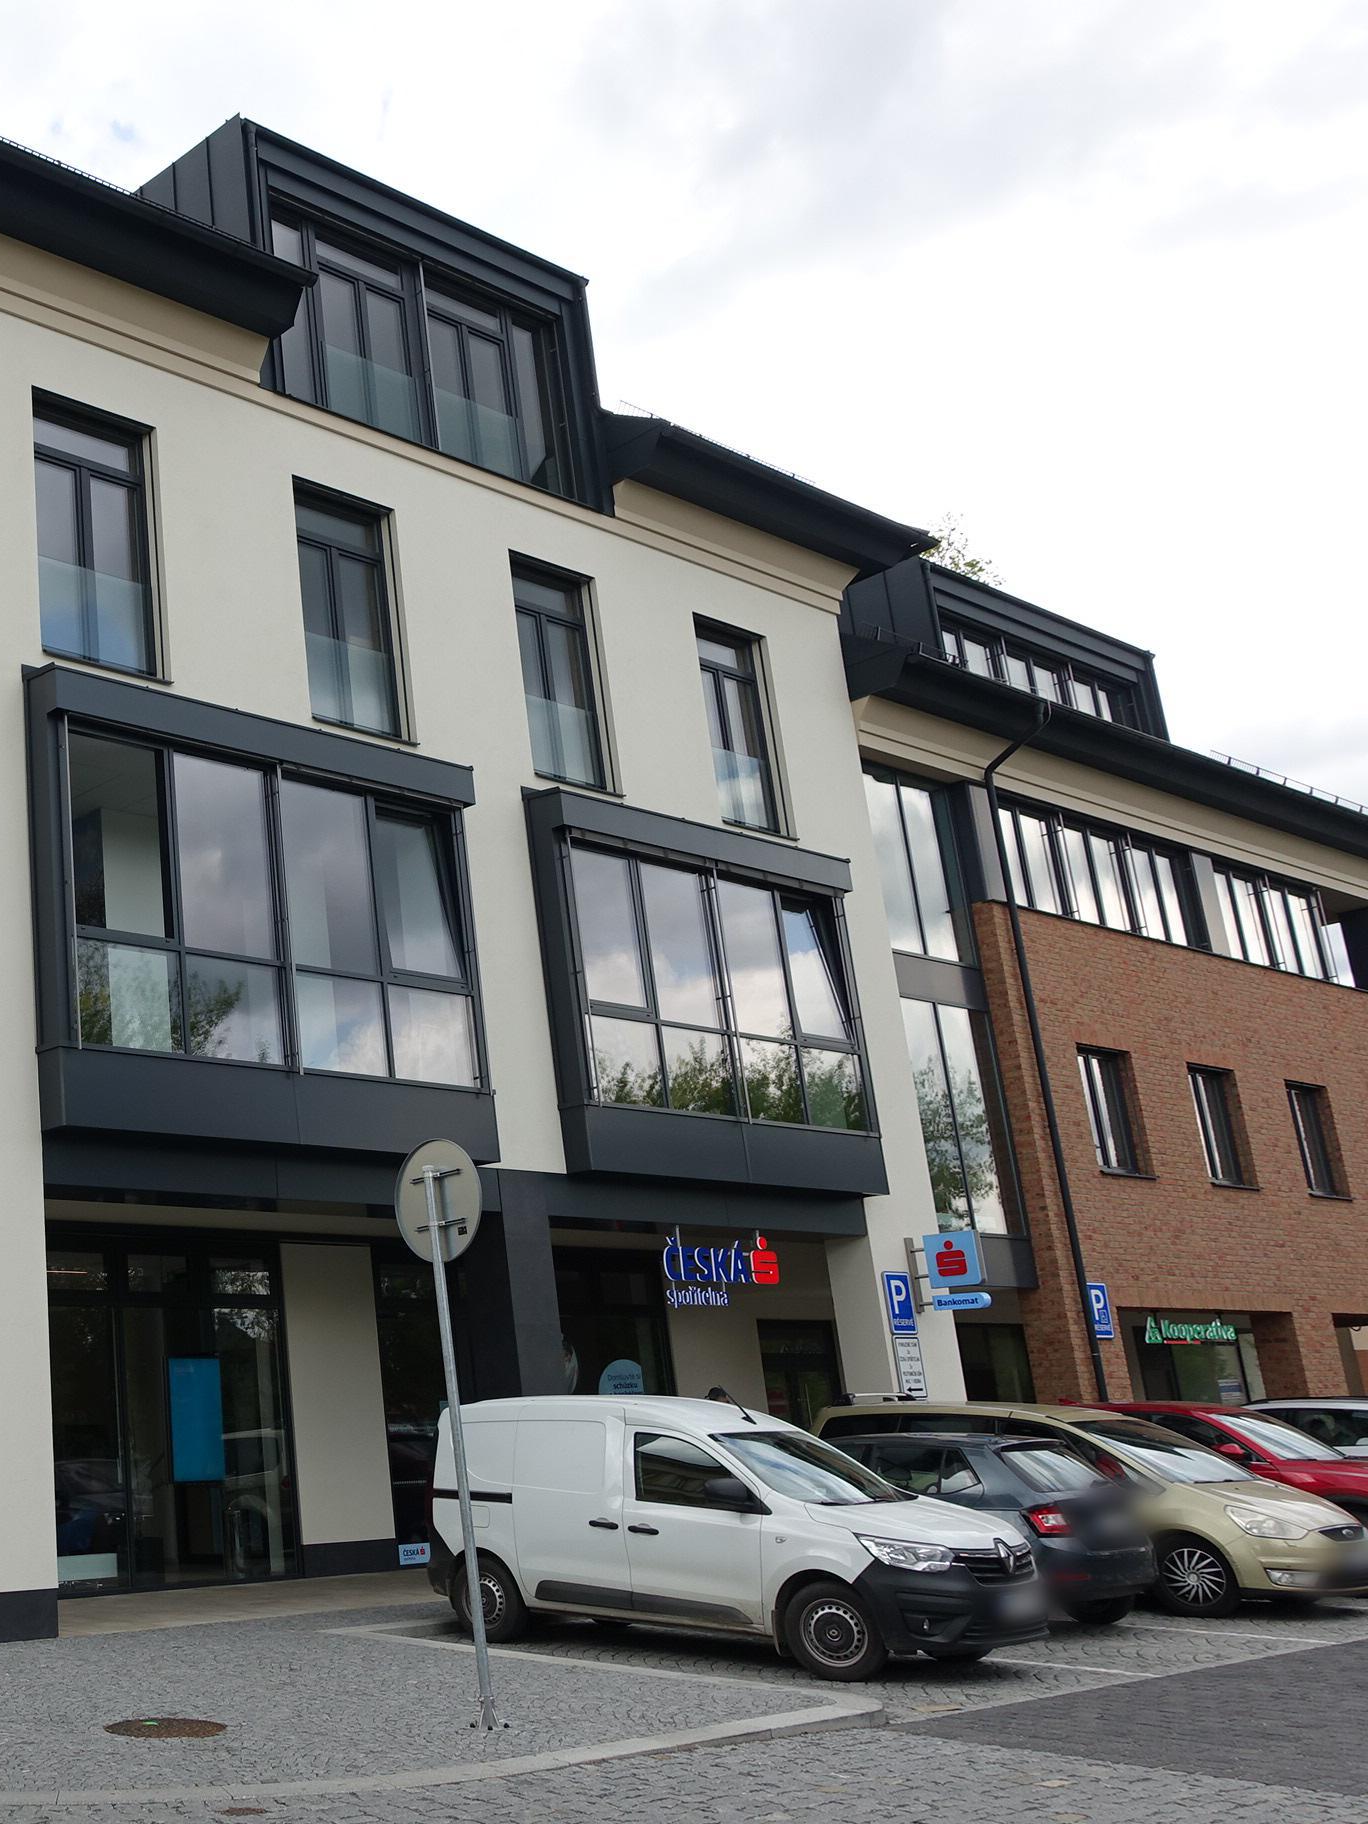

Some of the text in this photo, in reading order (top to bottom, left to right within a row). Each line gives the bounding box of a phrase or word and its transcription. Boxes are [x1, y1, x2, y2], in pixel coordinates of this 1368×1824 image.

[663, 1236, 752, 1284] ČESKÁ
[666, 1285, 729, 1309] spořitelna
[890, 1279, 907, 1314] P
[936, 1297, 979, 1307] Bankomat
[1090, 1289, 1104, 1320] P
[1160, 1318, 1238, 1342] Kooperativa
